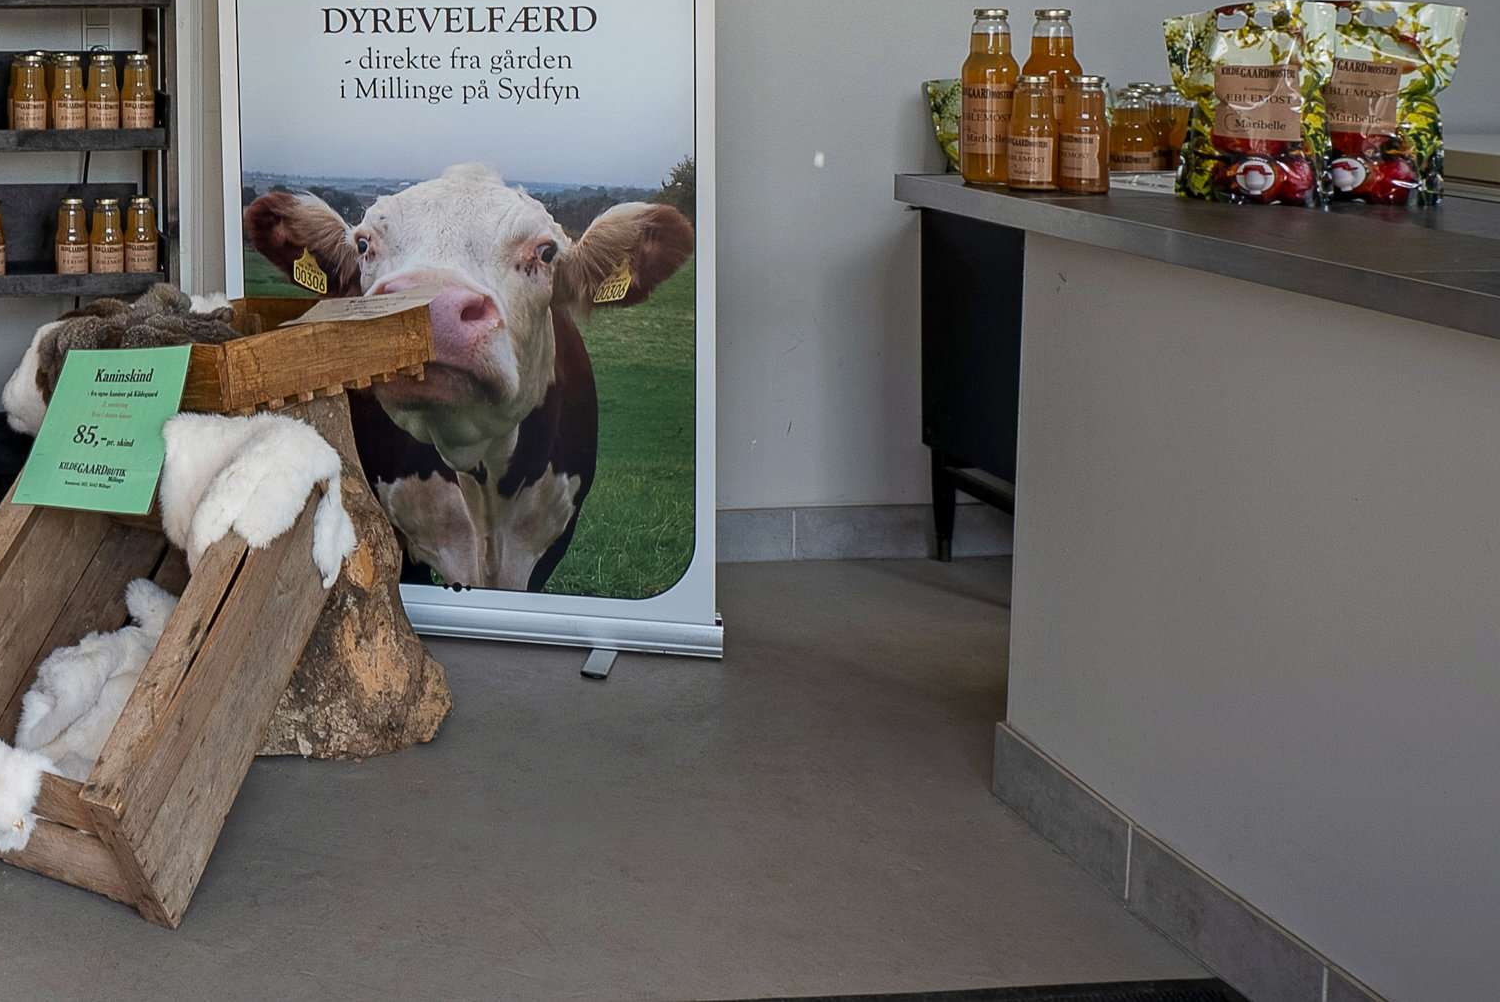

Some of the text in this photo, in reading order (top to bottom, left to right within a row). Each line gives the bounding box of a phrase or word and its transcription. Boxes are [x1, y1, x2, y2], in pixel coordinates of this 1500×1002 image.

[321, 5, 598, 34] DYREVELFÆRD
[358, 47, 442, 71] direkte
[450, 46, 481, 70] fra
[490, 47, 573, 74] gården
[339, 76, 581, 105] i Millinge på Sydfyn
[1235, 119, 1286, 131] Maribelle
[295, 266, 326, 292] 00306
[94, 368, 154, 383] Kaninskind
[72, 424, 107, 448] 85,-
[116, 438, 135, 447] skind
[58, 461, 127, 477] KILDEGAARDBUTIK
